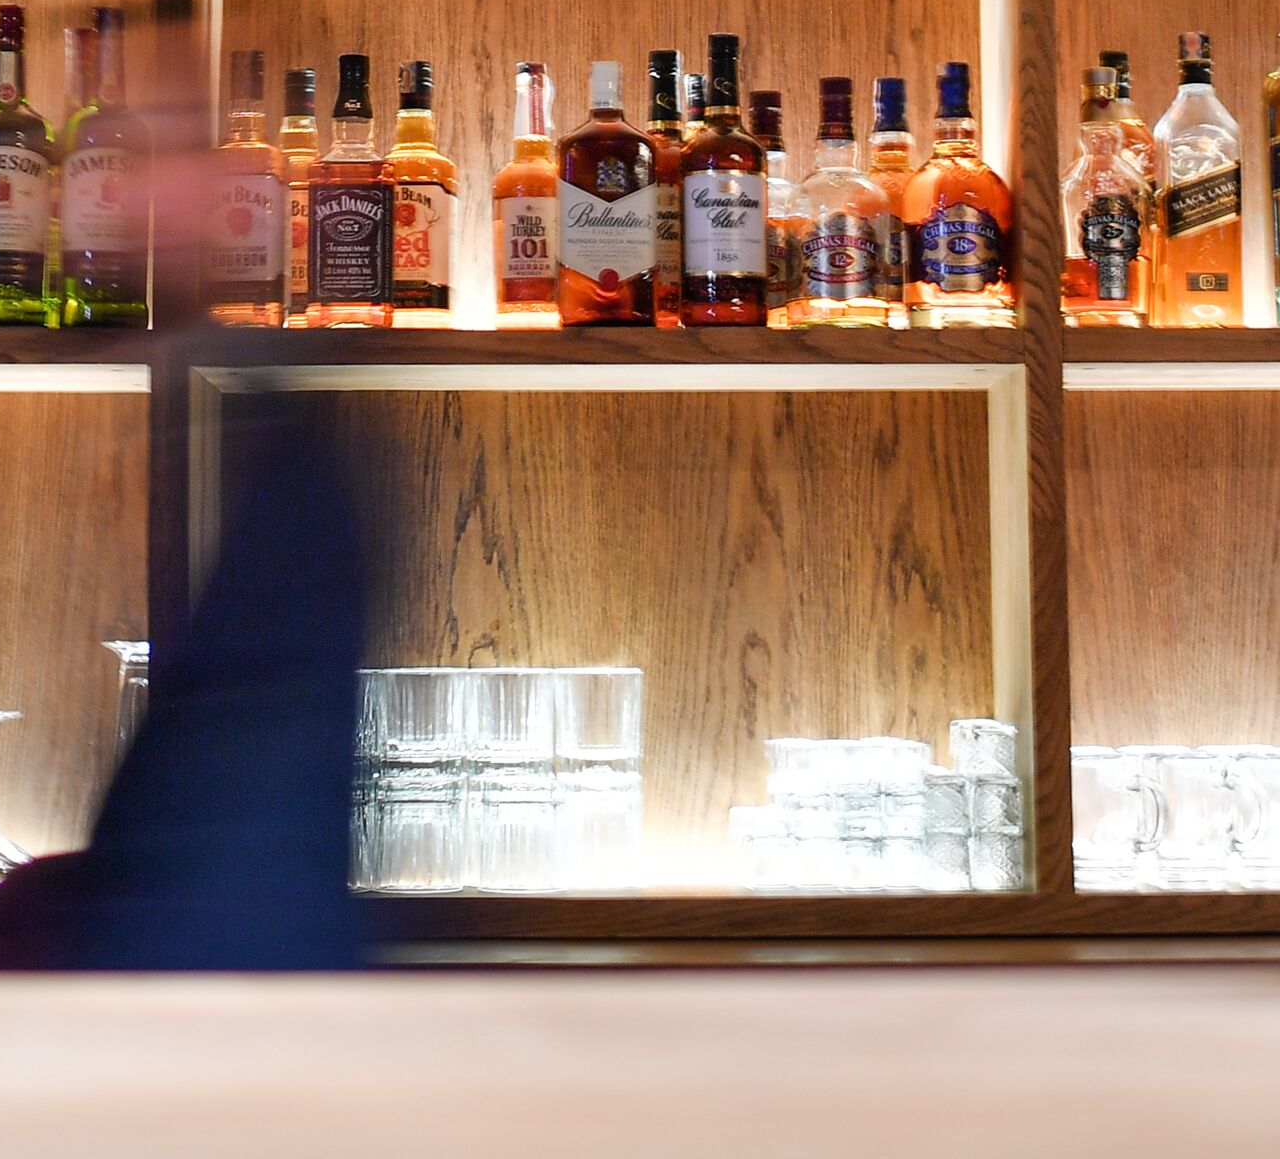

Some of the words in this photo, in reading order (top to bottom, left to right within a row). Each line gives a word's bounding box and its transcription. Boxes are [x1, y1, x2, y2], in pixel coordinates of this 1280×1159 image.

[401, 186, 432, 209] BEAM
[691, 187, 760, 209] Canadian
[1172, 193, 1207, 211] BLACK
[315, 201, 340, 221] JACK
[340, 195, 384, 220] DANIEL'S
[708, 207, 747, 229] Club
[511, 223, 547, 238] TURKEY
[516, 215, 542, 227] WILD
[923, 222, 964, 241] CHIVAS
[965, 221, 998, 240] REGAL
[325, 243, 371, 253] Tennessee
[395, 230, 430, 252] ed
[510, 238, 549, 259] 101
[803, 236, 841, 256] CHIVAS
[842, 235, 877, 255] REGAL
[954, 239, 969, 251] 18
[327, 257, 370, 267] WHISKEY
[835, 255, 847, 266] 12
